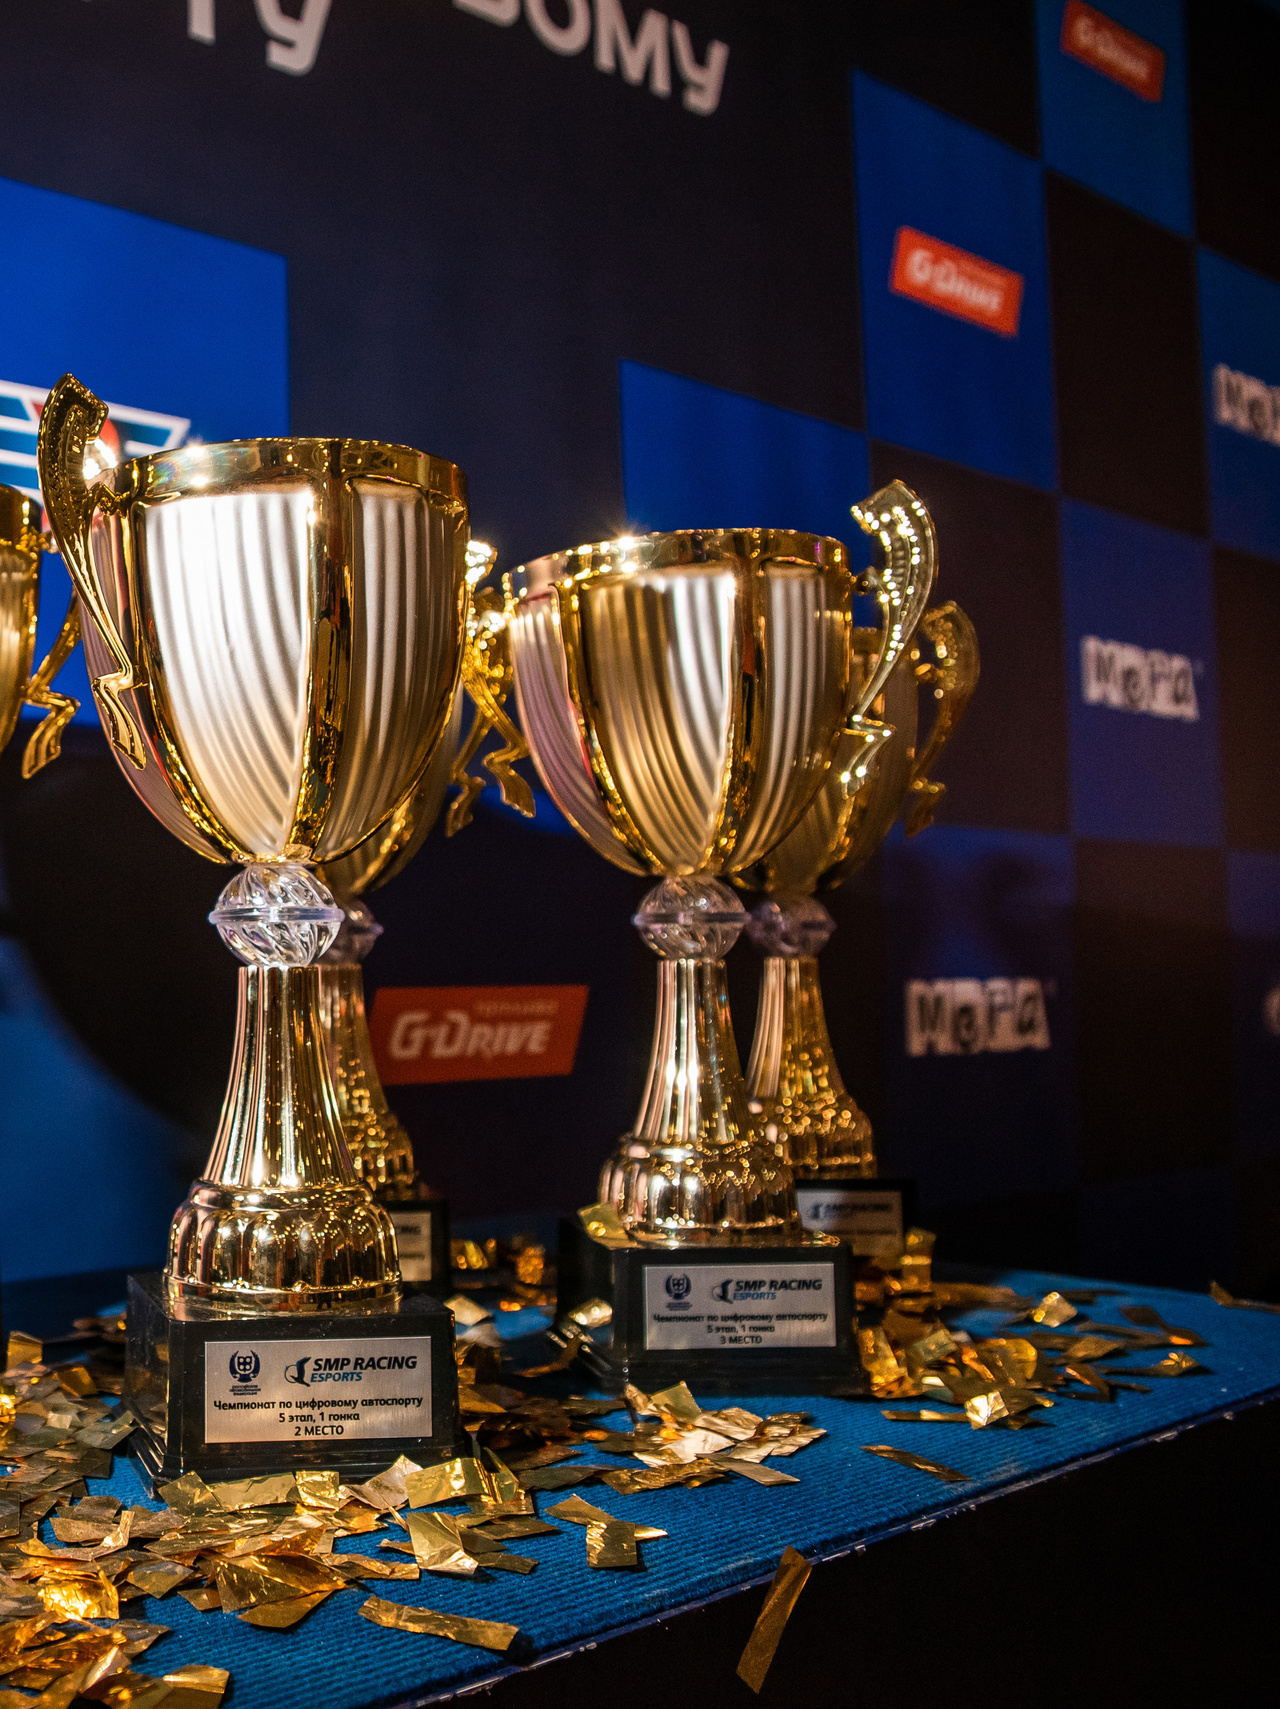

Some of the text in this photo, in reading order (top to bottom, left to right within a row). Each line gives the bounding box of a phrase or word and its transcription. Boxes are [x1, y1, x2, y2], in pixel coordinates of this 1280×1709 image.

[734, 1279, 823, 1291] SMP RACING
[733, 1291, 777, 1300] ESPORTS
[707, 1324, 713, 1333] 5
[741, 1324, 746, 1332] 1
[720, 1335, 762, 1344] 3 МЕСТО
[312, 1355, 418, 1371] SMP RACING
[310, 1371, 363, 1383] ESPORTS
[213, 1397, 423, 1411] Чемпионат по цифровому автоспорту
[278, 1412, 360, 1423] 5 этап, 1 гонка
[294, 1425, 344, 1436] 2 МЕСТО
